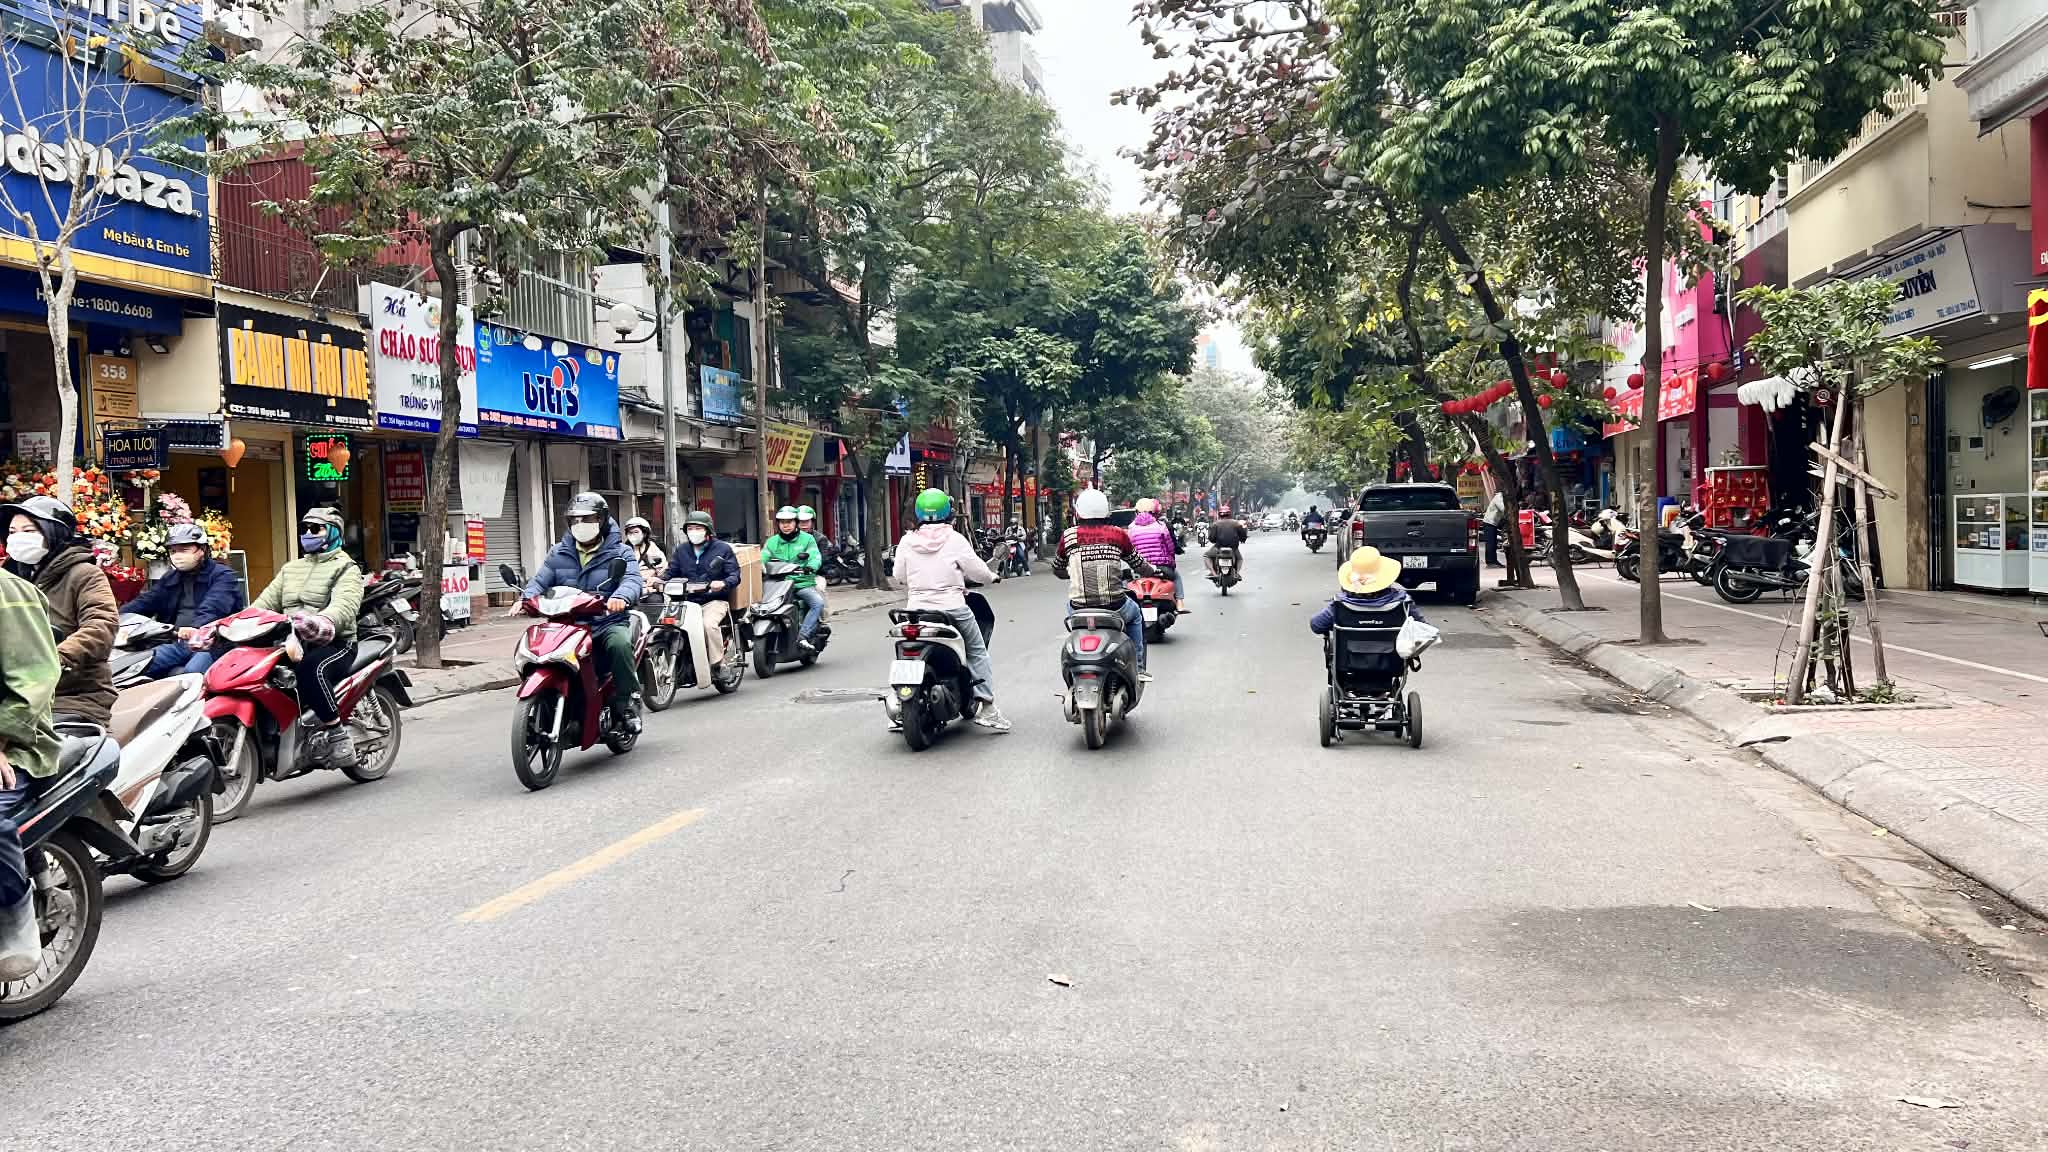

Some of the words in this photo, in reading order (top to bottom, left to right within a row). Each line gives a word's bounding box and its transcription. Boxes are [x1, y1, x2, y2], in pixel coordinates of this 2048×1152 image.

[103, 227, 122, 246] Mẹ
[146, 237, 155, 250] &
[156, 239, 174, 255] Em
[175, 243, 190, 258] bé
[380, 324, 415, 360] CHÁO
[100, 364, 128, 380] 358
[228, 320, 285, 390] BÁNH
[342, 347, 369, 400] AN
[109, 439, 131, 453] HOA
[441, 572, 469, 594] HÁO
